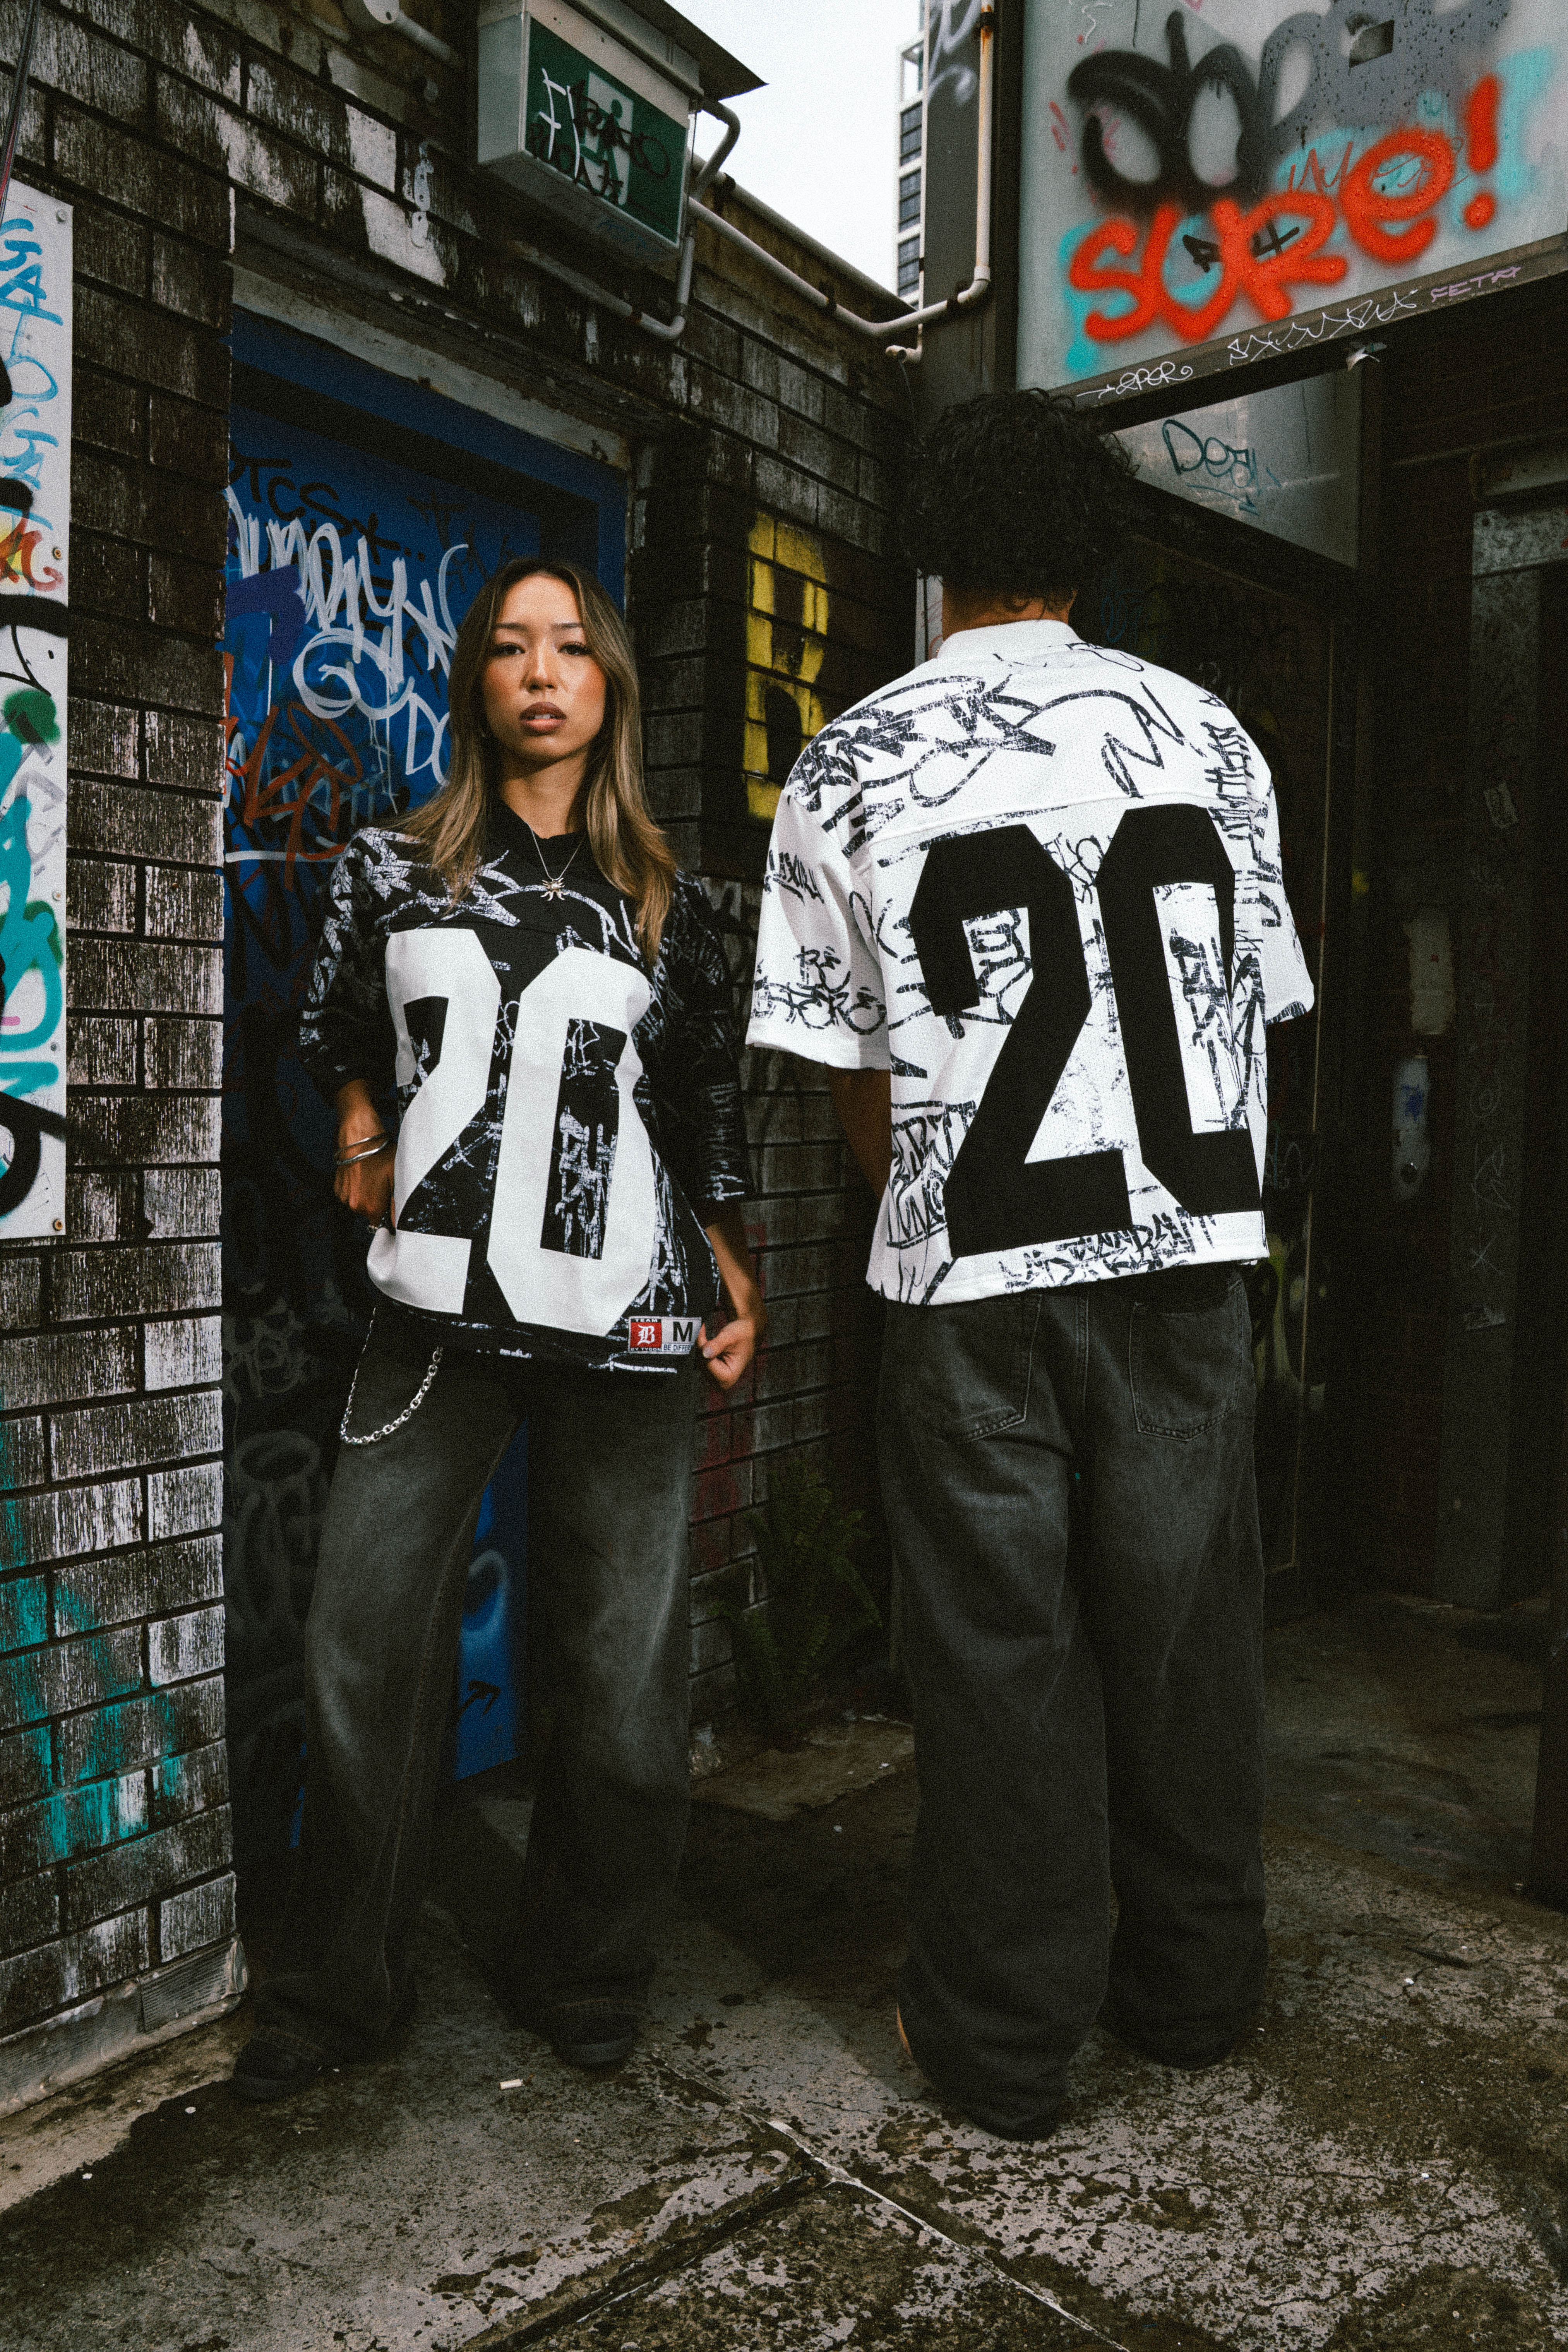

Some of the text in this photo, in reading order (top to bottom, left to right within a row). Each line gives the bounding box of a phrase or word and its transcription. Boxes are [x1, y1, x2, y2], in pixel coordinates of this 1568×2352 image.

[366, 928, 657, 1337] 20
[908, 803, 1264, 1257] 20
[673, 1321, 693, 1342] M
